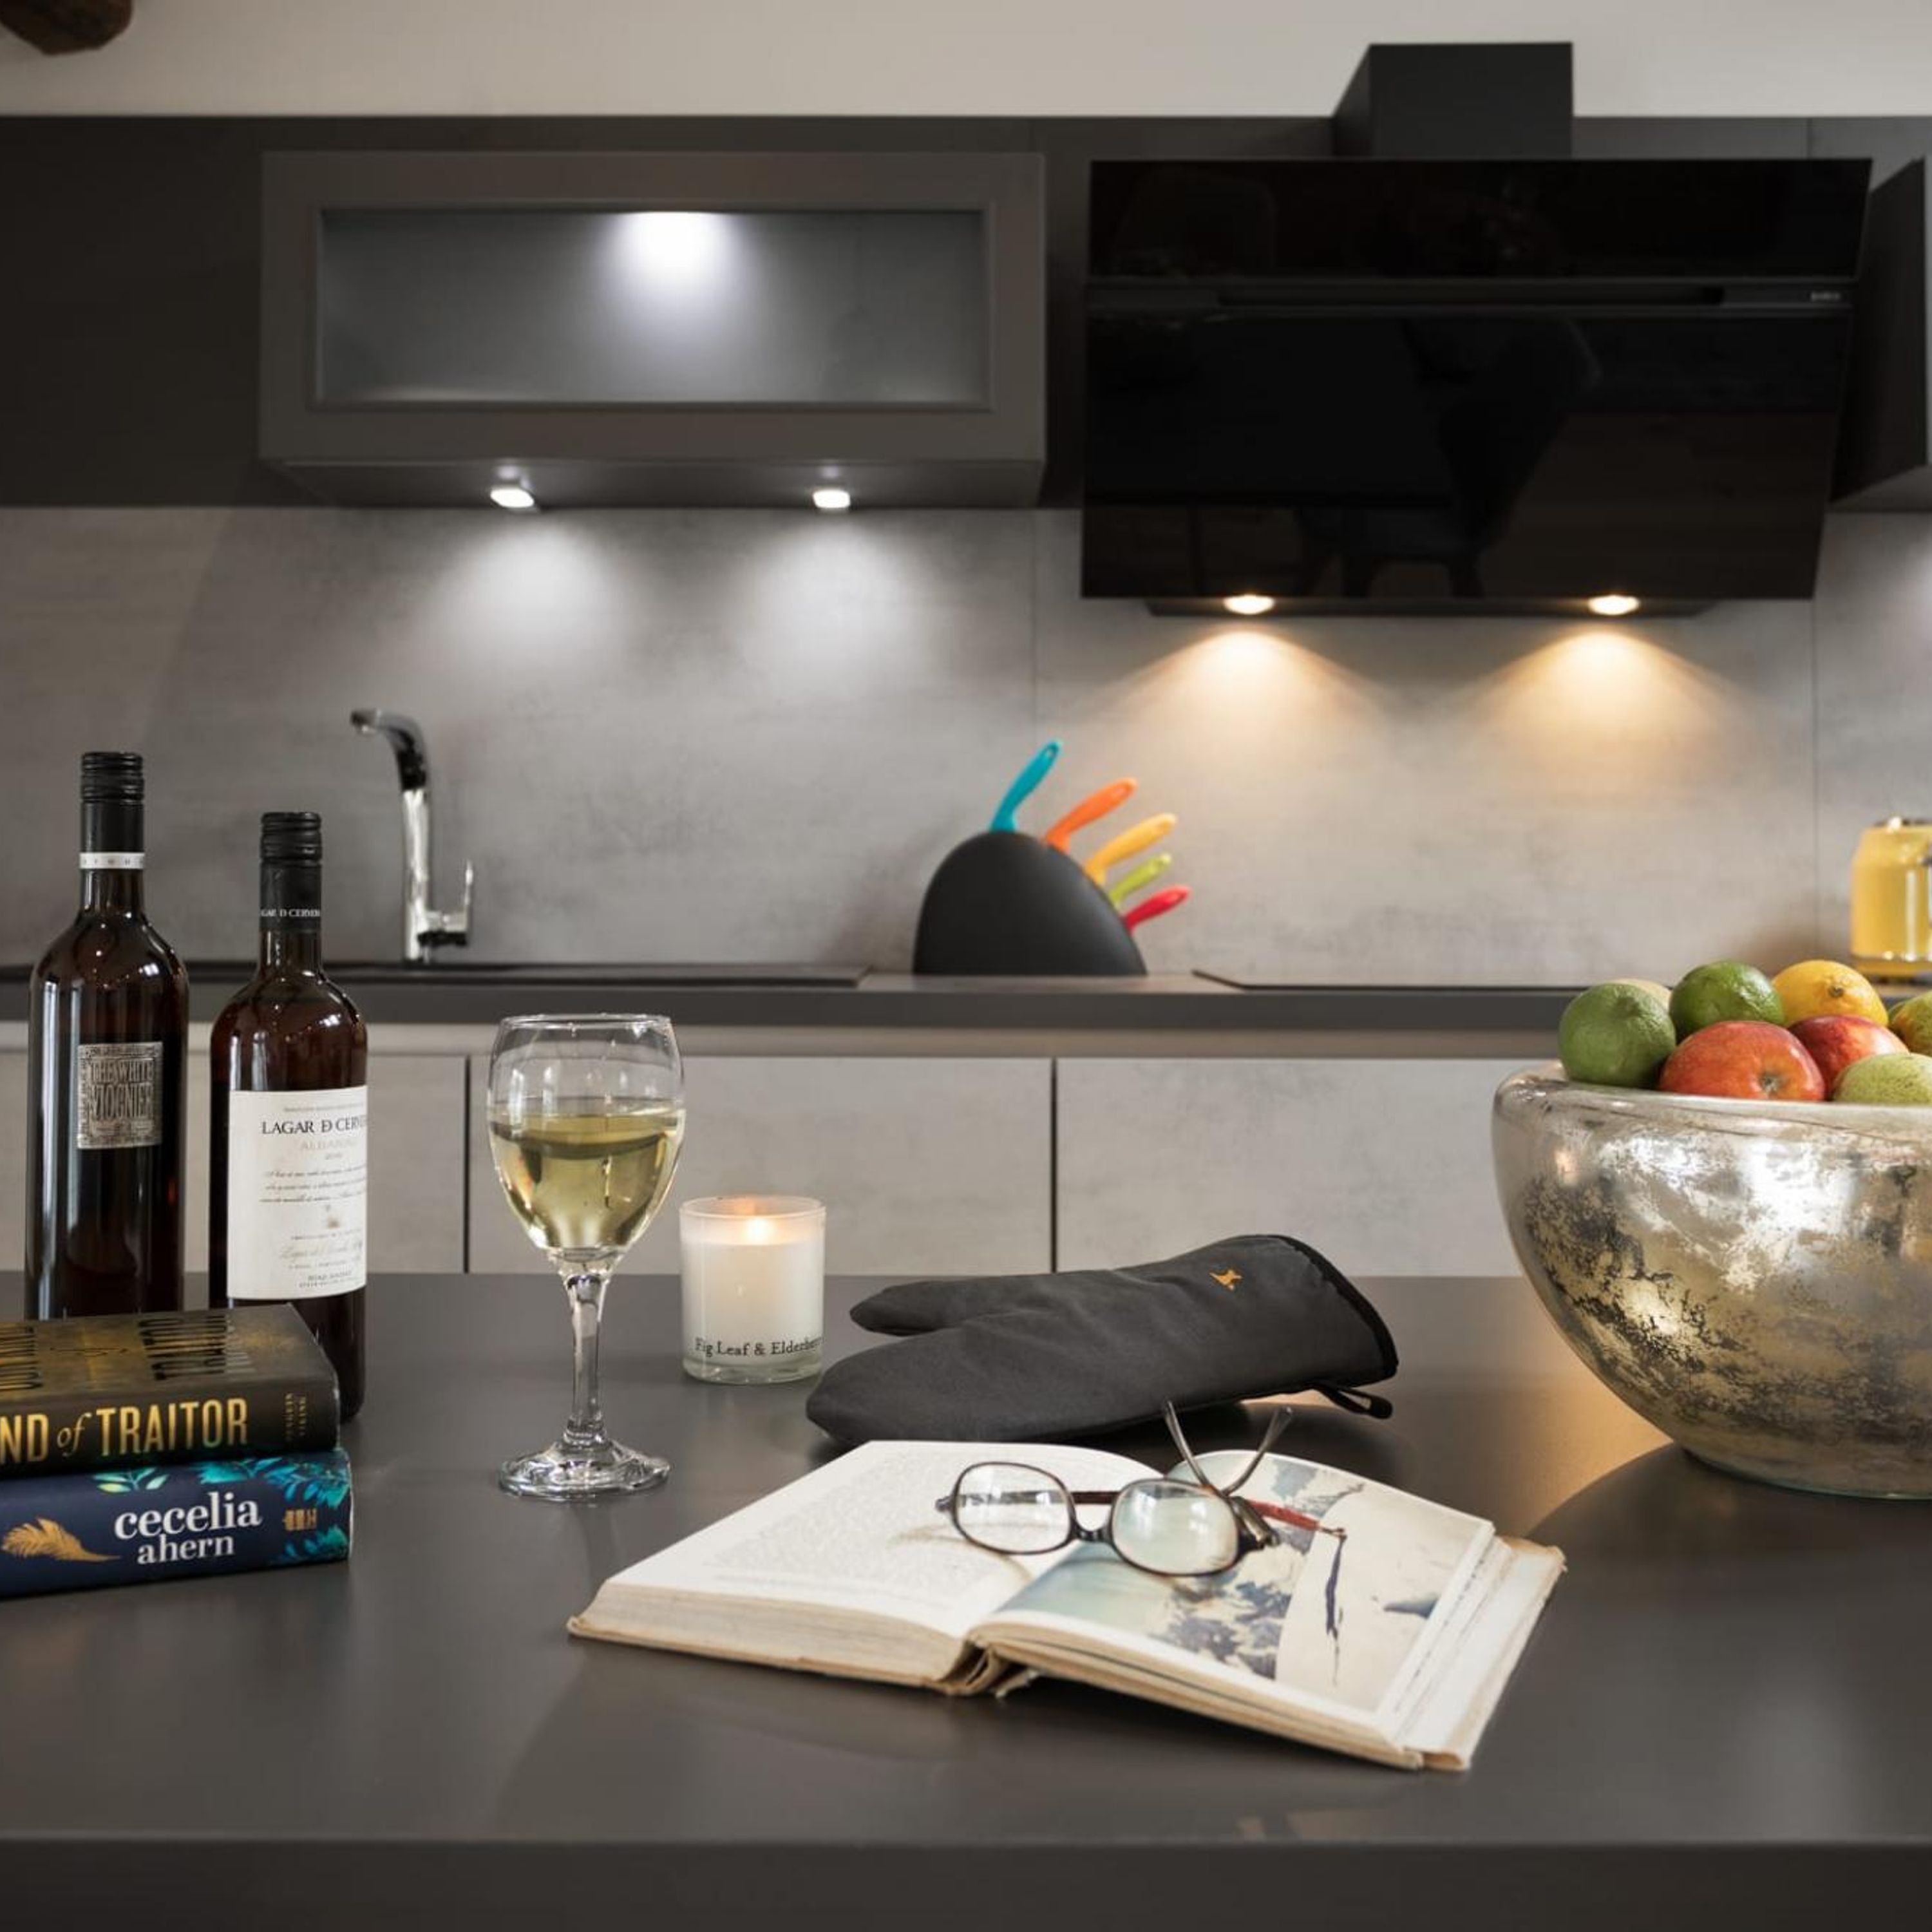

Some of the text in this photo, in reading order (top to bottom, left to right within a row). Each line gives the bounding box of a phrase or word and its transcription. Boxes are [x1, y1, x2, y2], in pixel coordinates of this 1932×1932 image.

[261, 1121, 315, 1134] LAGAR
[695, 1336, 714, 1357] Fig
[717, 1340, 750, 1356] Leaf
[754, 1342, 766, 1356] &
[0, 1414, 50, 1464] ND
[57, 1412, 92, 1457] of
[96, 1397, 248, 1457] TRAITOR
[114, 1491, 263, 1540] cecelia
[137, 1534, 235, 1565] ahern
